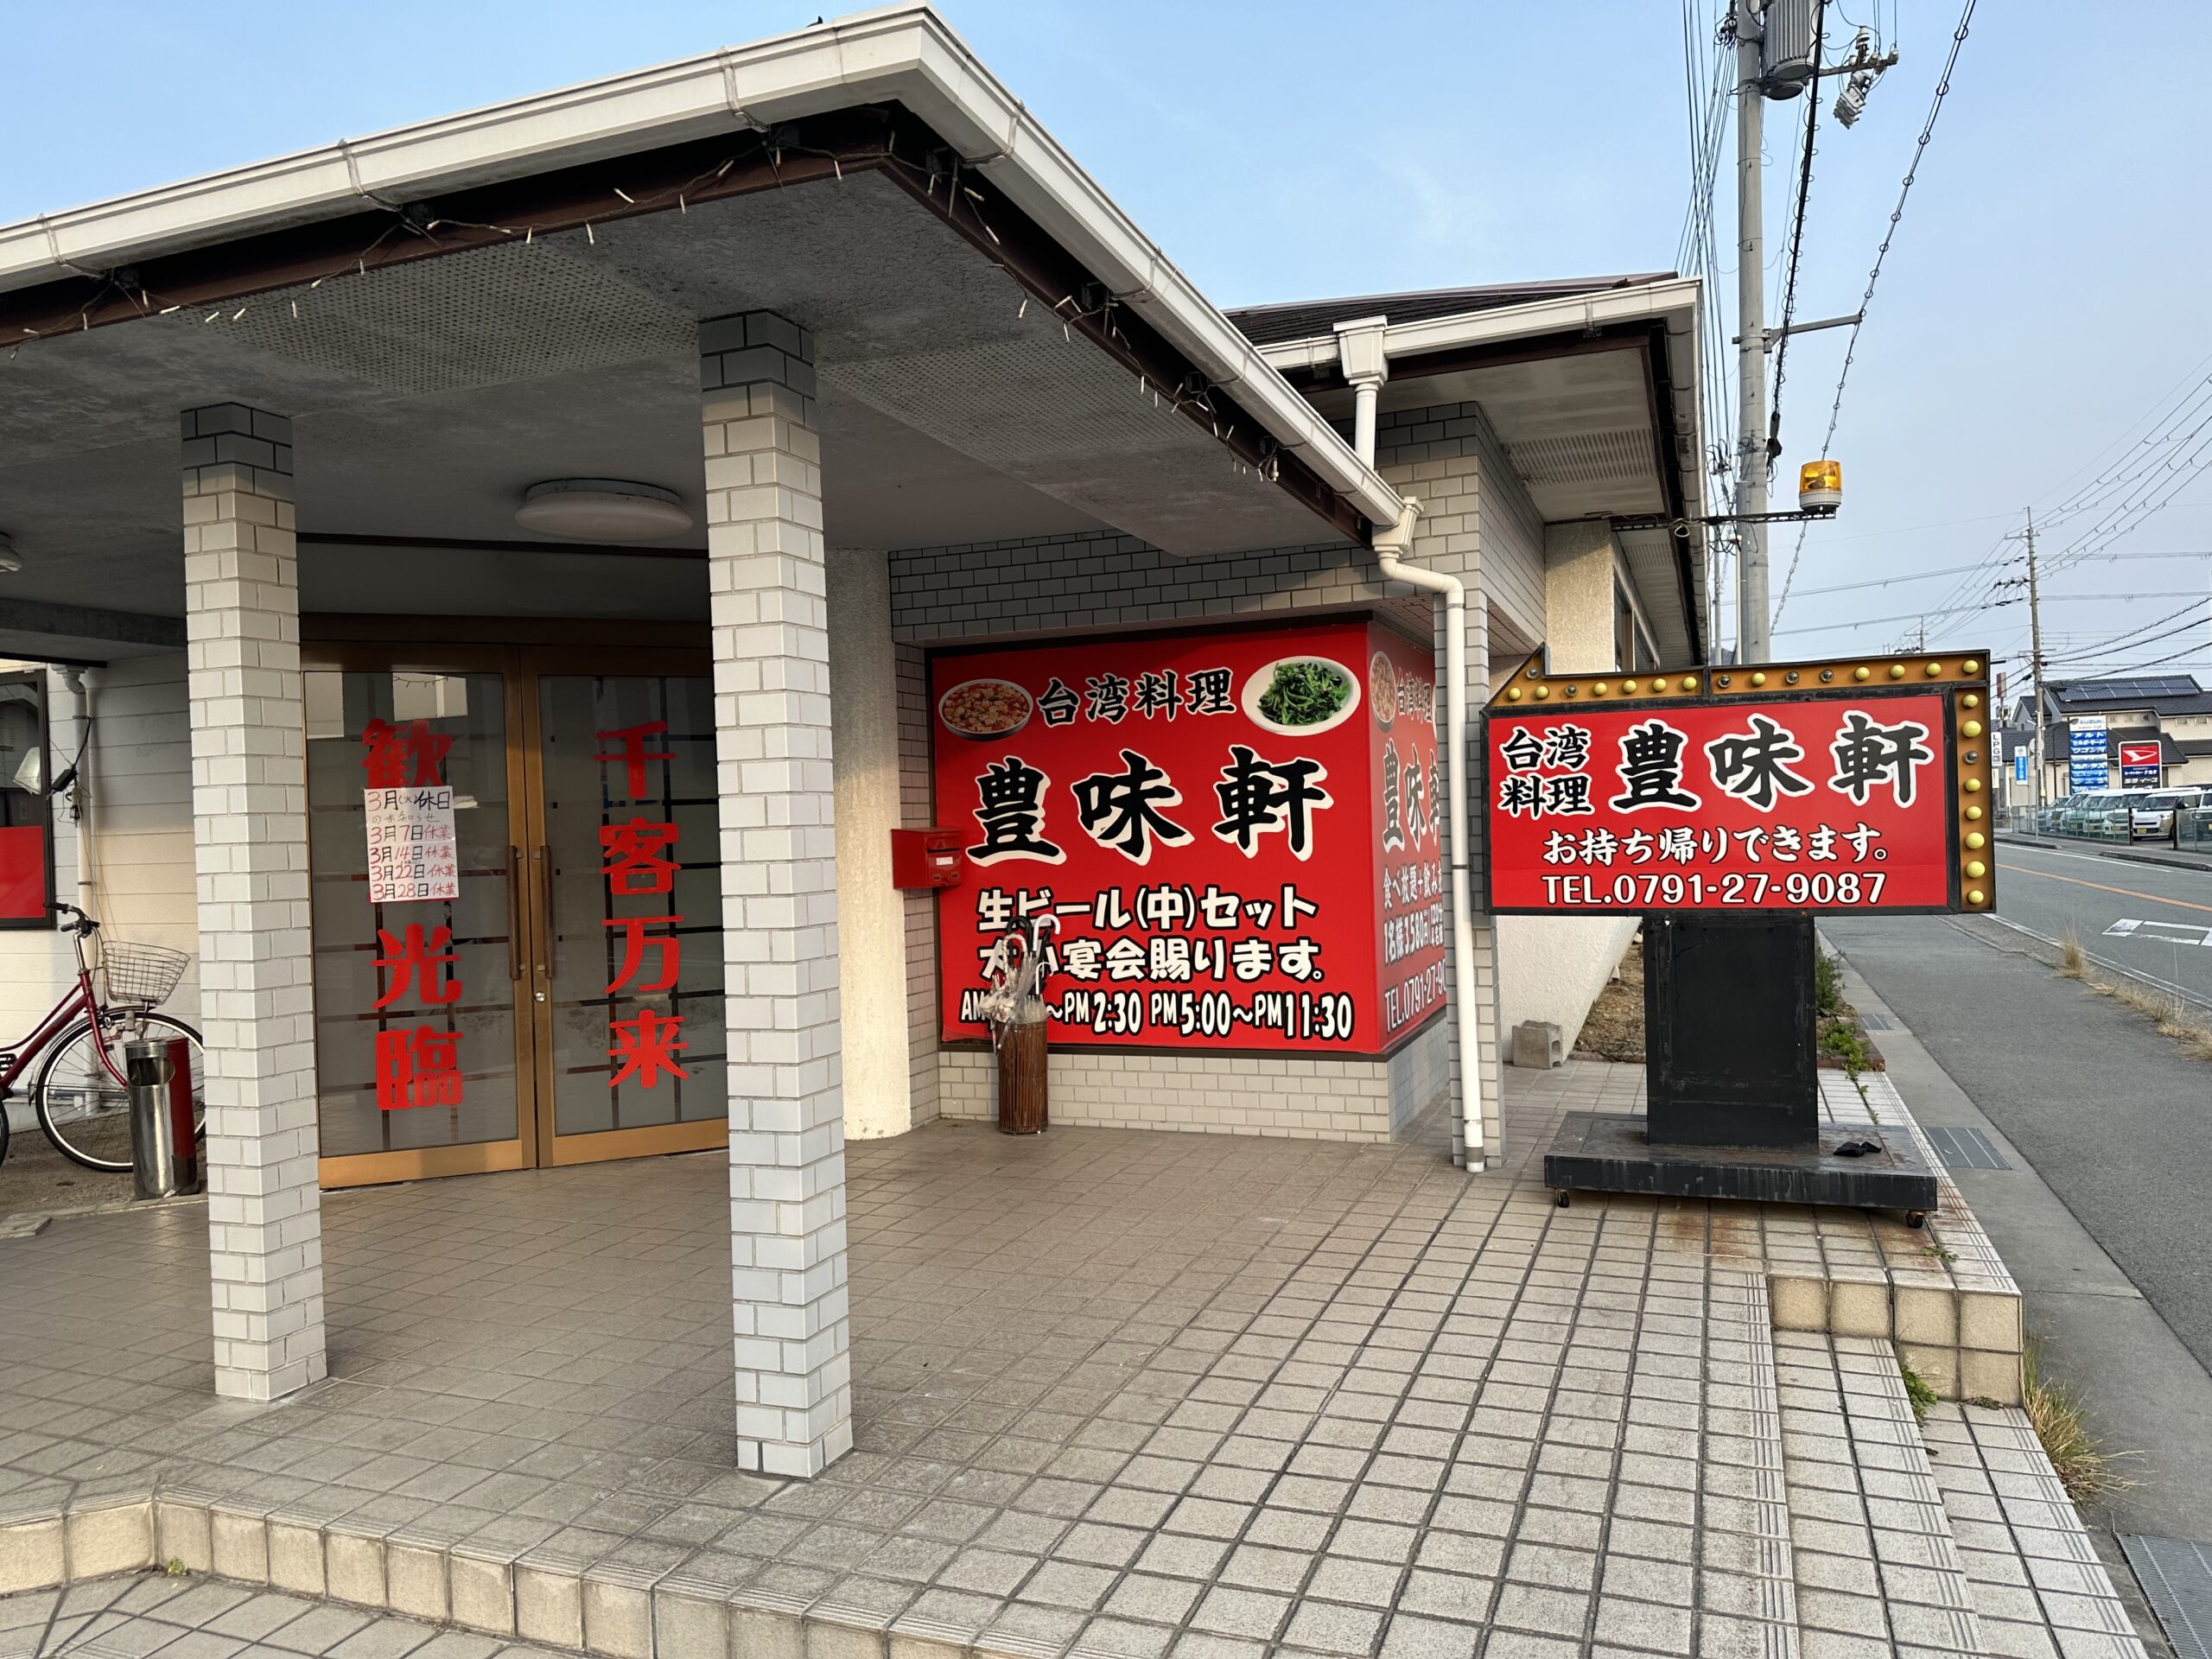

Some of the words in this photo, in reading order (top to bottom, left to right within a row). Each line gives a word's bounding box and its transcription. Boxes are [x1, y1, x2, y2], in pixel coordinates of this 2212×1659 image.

[1036, 666, 1237, 728] 台湾料理
[1396, 667, 1432, 724] 台湾料理
[1498, 723, 1592, 772] 台湾
[1608, 709, 1936, 815] 豊味軒
[965, 744, 1335, 866] 豊味軒
[1497, 773, 1594, 820] 料理
[1542, 823, 1889, 867] お持ち帰りできます。
[360, 717, 464, 1111] 歓光臨
[594, 720, 690, 1089] 千客万来
[1541, 872, 1887, 906] TEL.0791-27-9087
